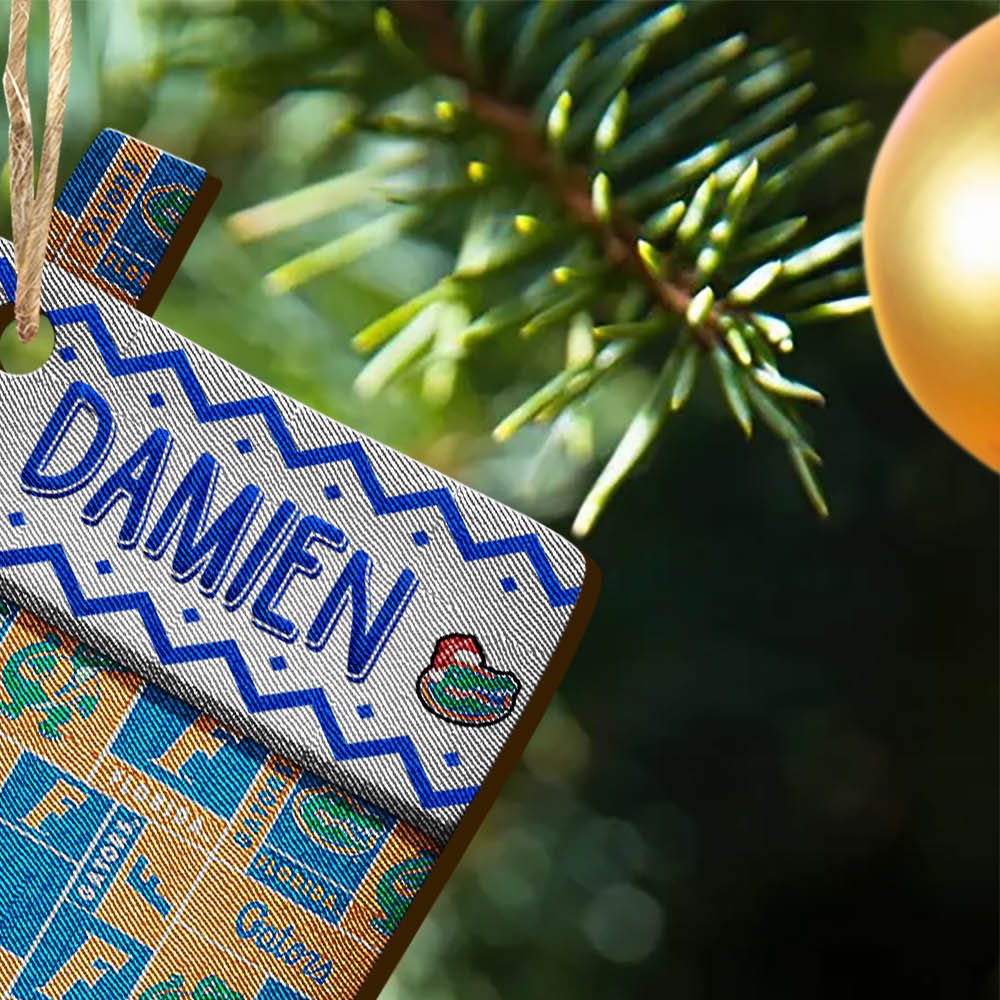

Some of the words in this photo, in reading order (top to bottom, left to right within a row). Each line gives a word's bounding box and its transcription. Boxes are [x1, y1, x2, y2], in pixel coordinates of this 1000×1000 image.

[78, 157, 145, 250] GATORS
[17, 380, 424, 683] DAMIEN
[148, 711, 244, 784] F
[17, 778, 89, 834] F
[74, 818, 136, 904] GATORS
[255, 852, 339, 913] FLORIDA
[236, 902, 330, 984] Gators
